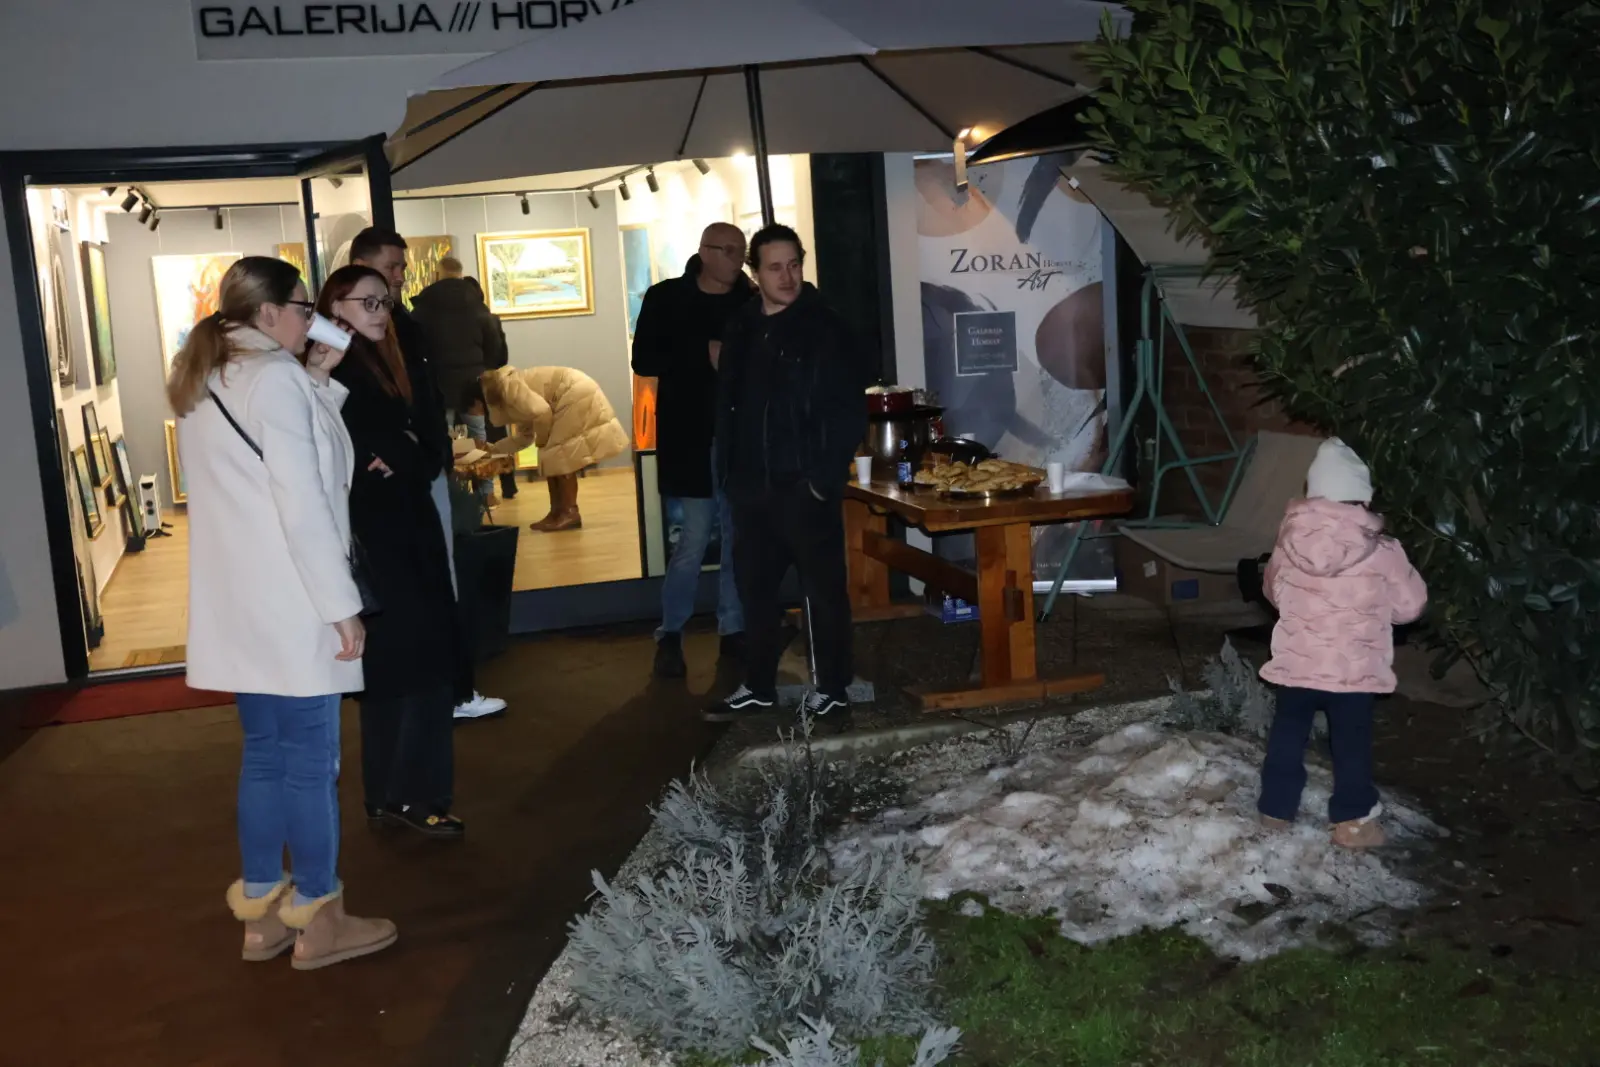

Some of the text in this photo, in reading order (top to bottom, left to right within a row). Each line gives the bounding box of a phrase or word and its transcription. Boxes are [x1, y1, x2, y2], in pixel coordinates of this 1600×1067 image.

[200, 3, 442, 37] GALERIJA
[950, 249, 1041, 273] ZORAN
[1016, 269, 1063, 291] Art
